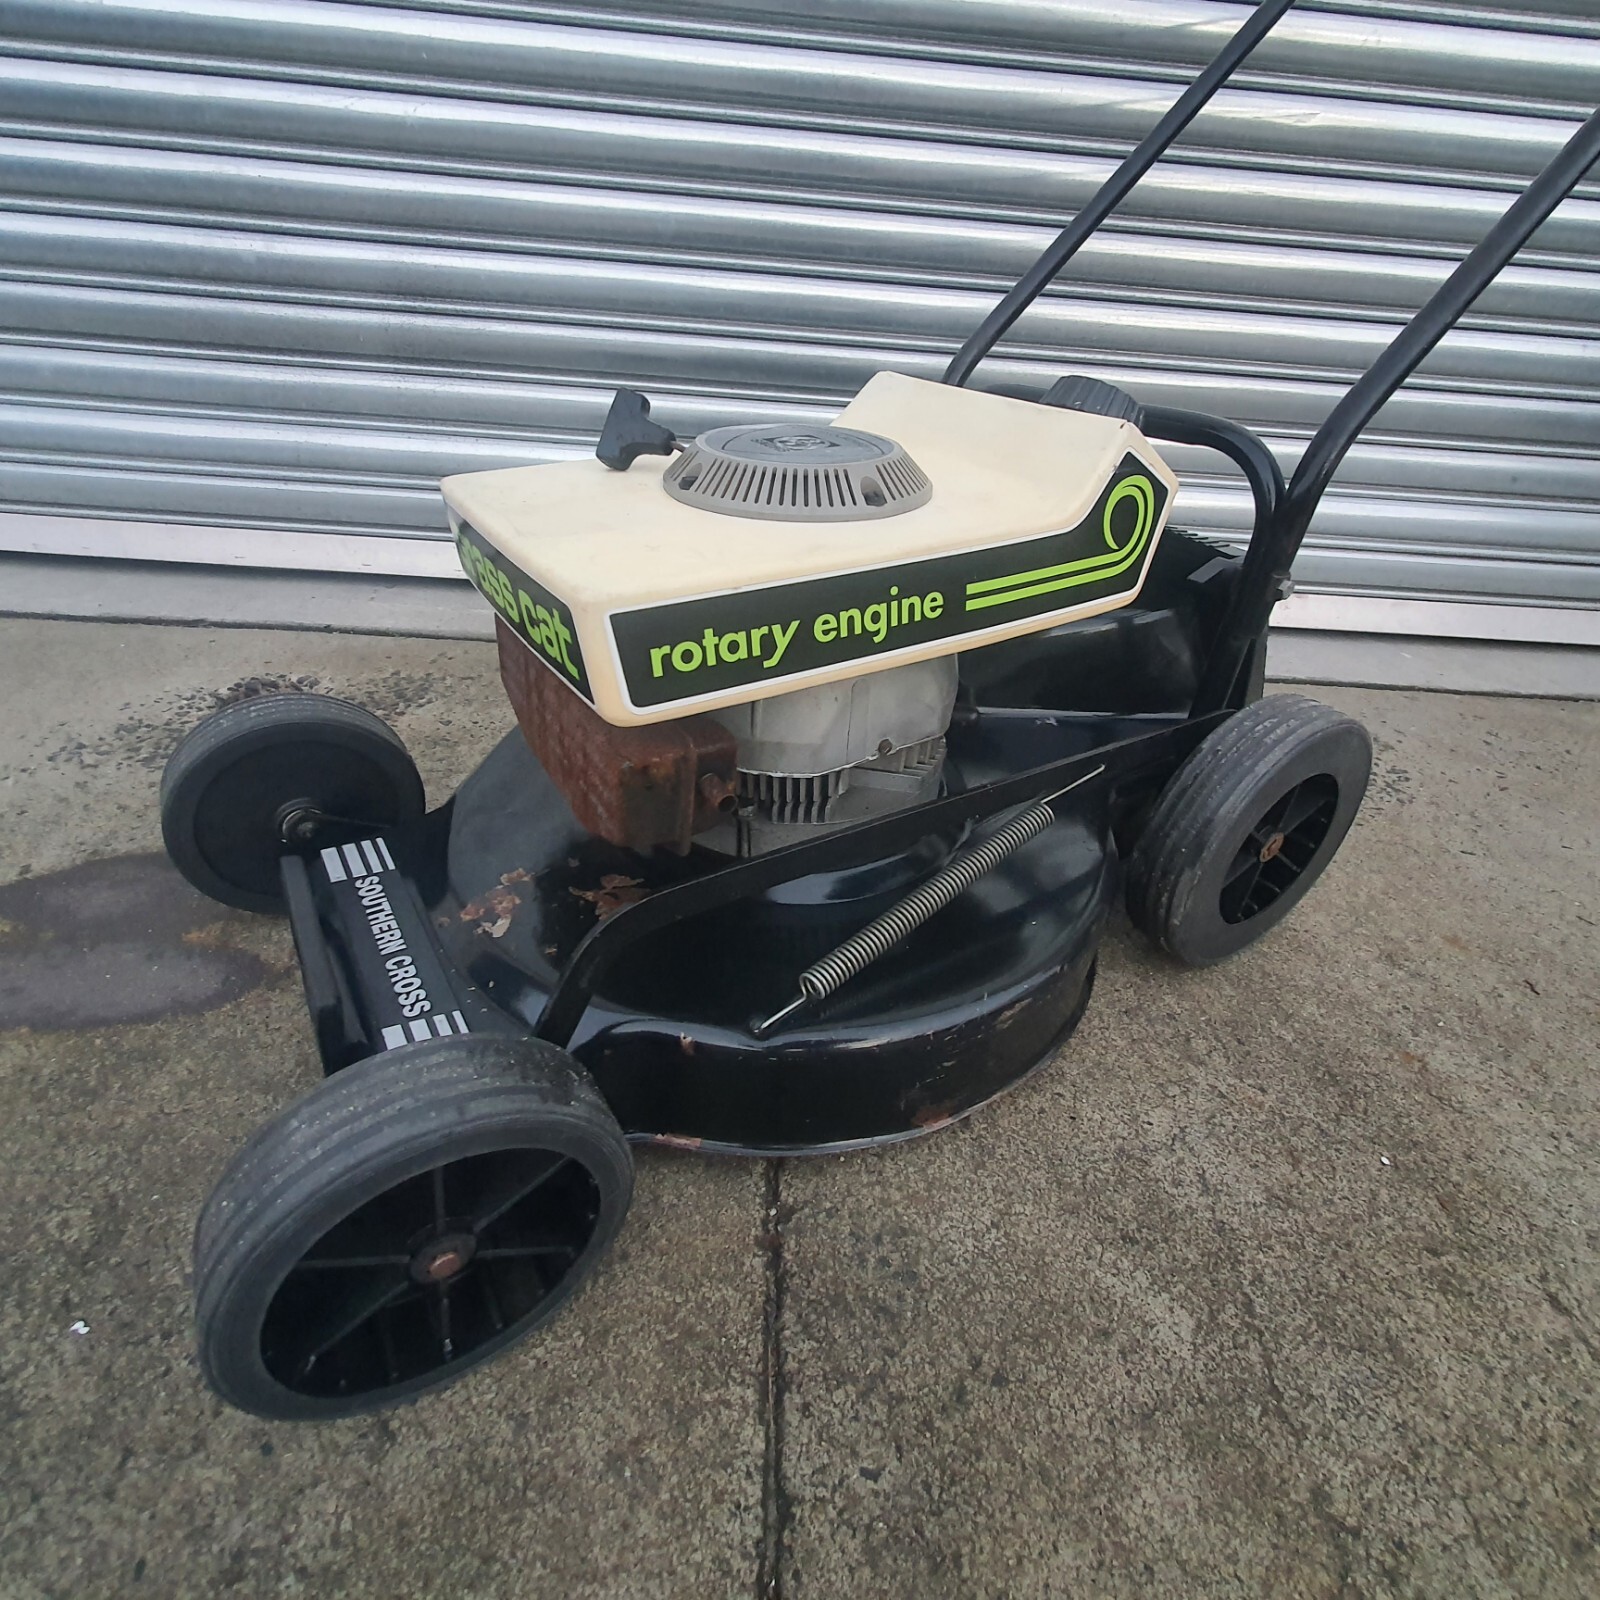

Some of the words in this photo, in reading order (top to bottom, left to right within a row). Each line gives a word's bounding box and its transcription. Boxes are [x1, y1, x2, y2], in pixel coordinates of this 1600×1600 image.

[518, 588, 580, 682] cat
[649, 619, 801, 678] rotary
[813, 585, 945, 644] engine
[354, 875, 407, 956] SOUTHERN
[384, 955, 432, 1018] CROSS
